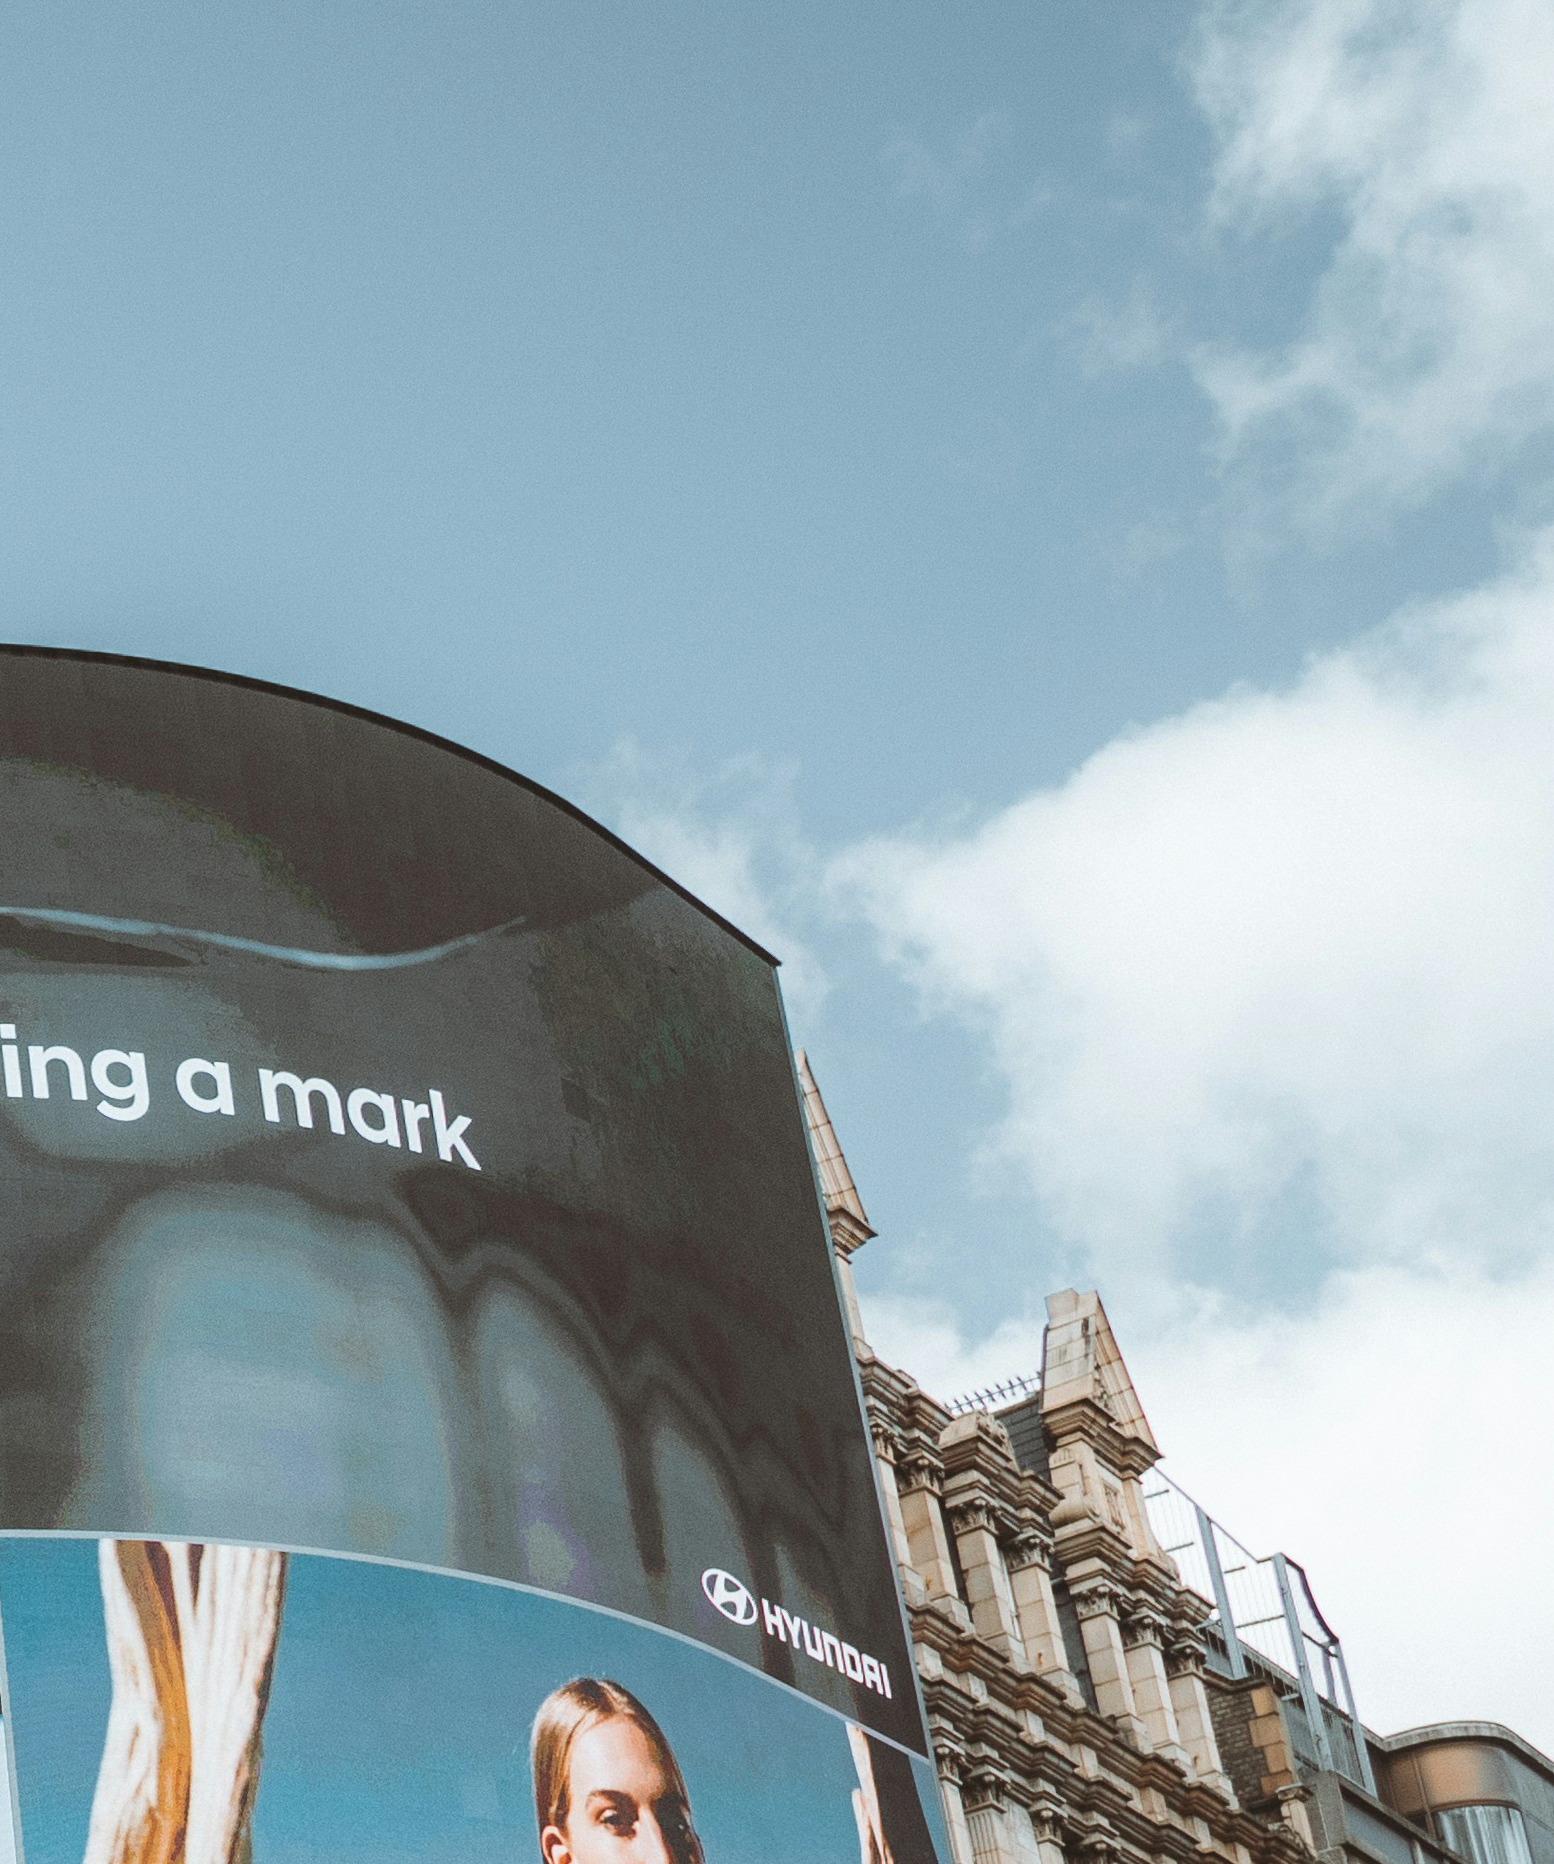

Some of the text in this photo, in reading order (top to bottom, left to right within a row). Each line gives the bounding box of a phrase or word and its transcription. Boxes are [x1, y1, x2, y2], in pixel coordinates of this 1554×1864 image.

[176, 1056, 236, 1116] a
[259, 1067, 483, 1171] mark
[761, 1597, 892, 1700] HYUNDAI
